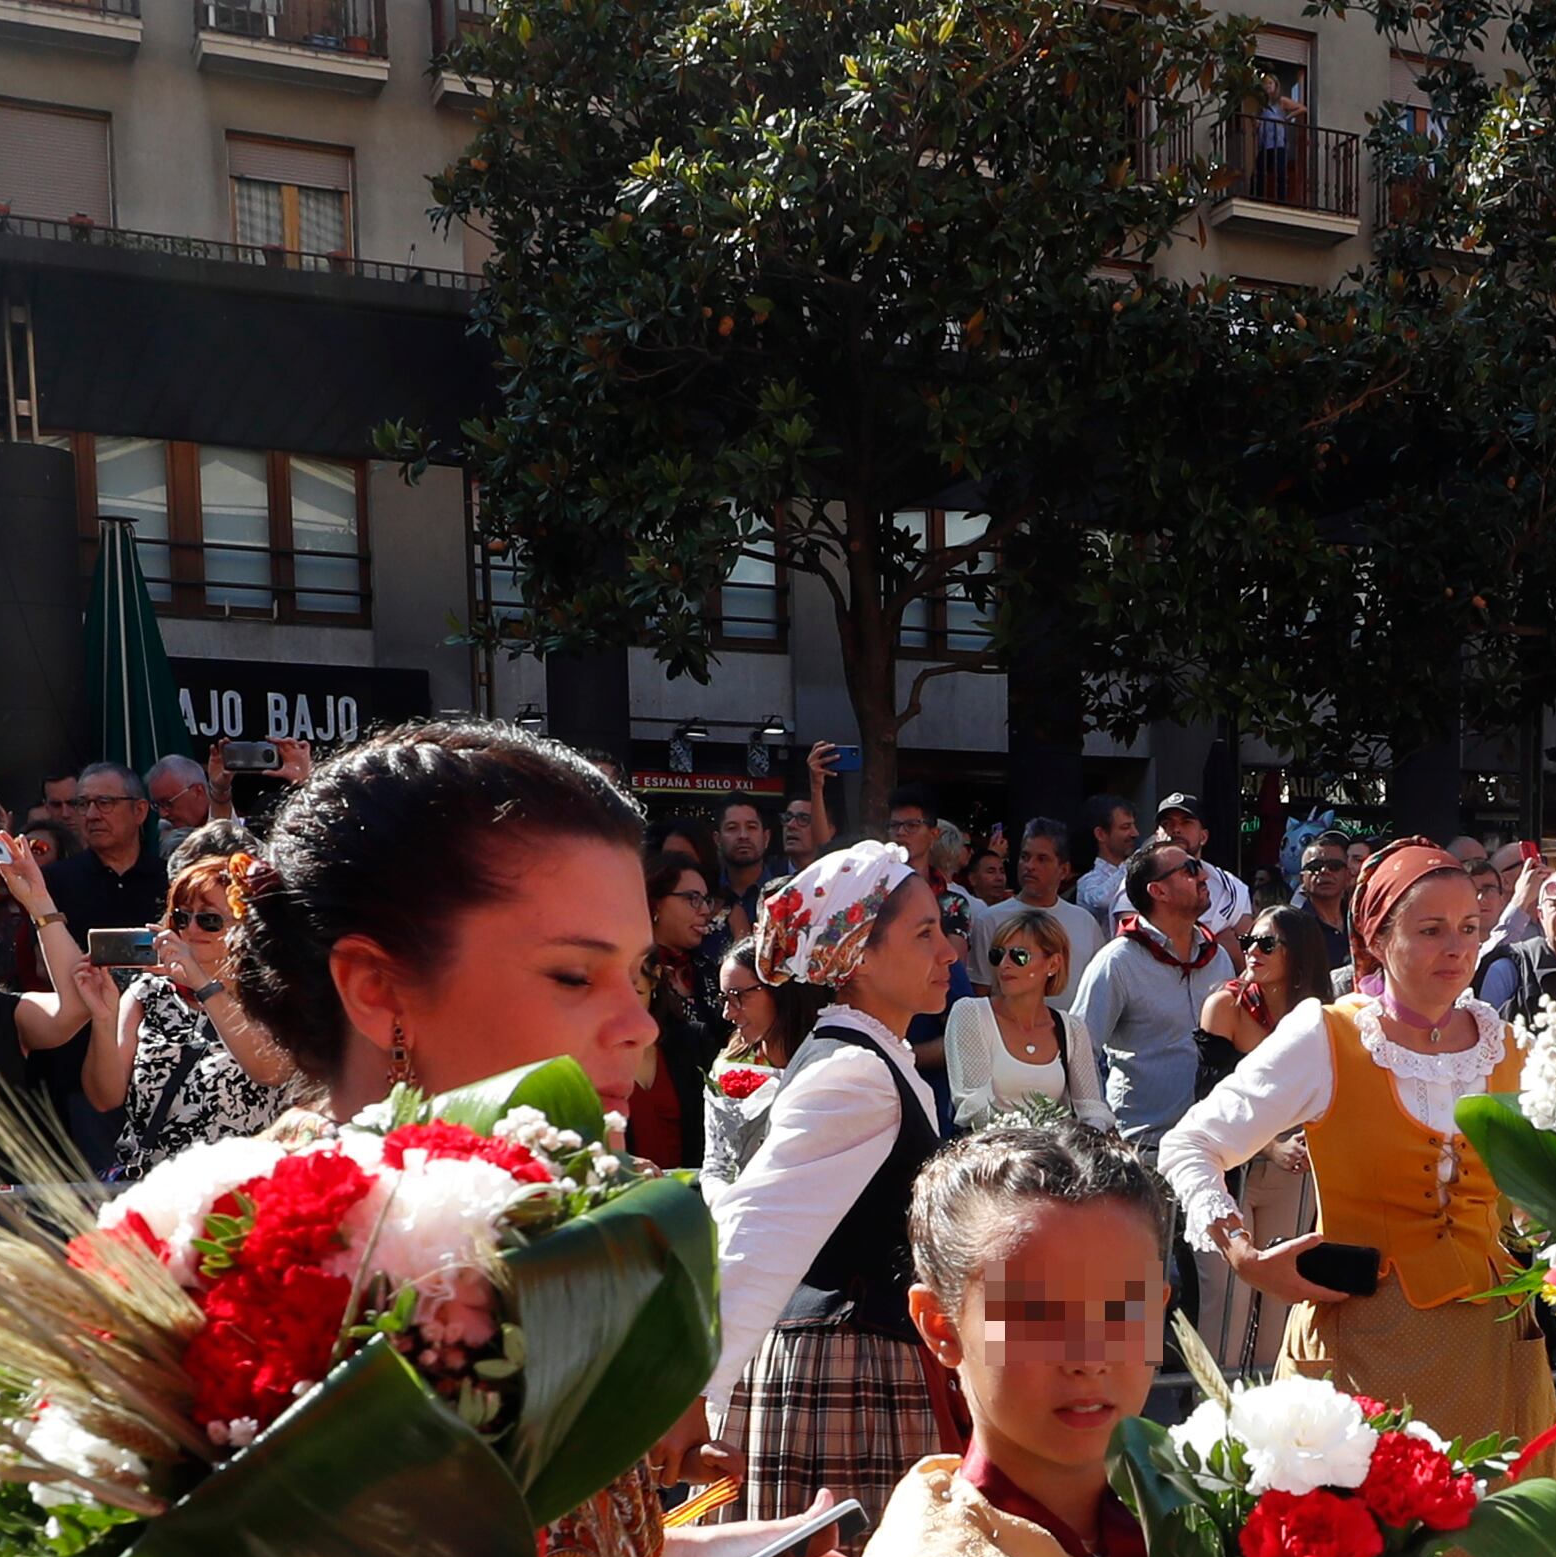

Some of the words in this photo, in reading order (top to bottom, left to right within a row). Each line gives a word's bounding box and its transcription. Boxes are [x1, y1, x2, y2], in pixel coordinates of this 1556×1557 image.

[178, 687, 243, 738] AJO
[266, 691, 358, 743] BAJO
[631, 775, 639, 787] E
[643, 775, 692, 789] ESPAÑA
[695, 778, 732, 790] SIGLO
[734, 779, 755, 791] XXI
